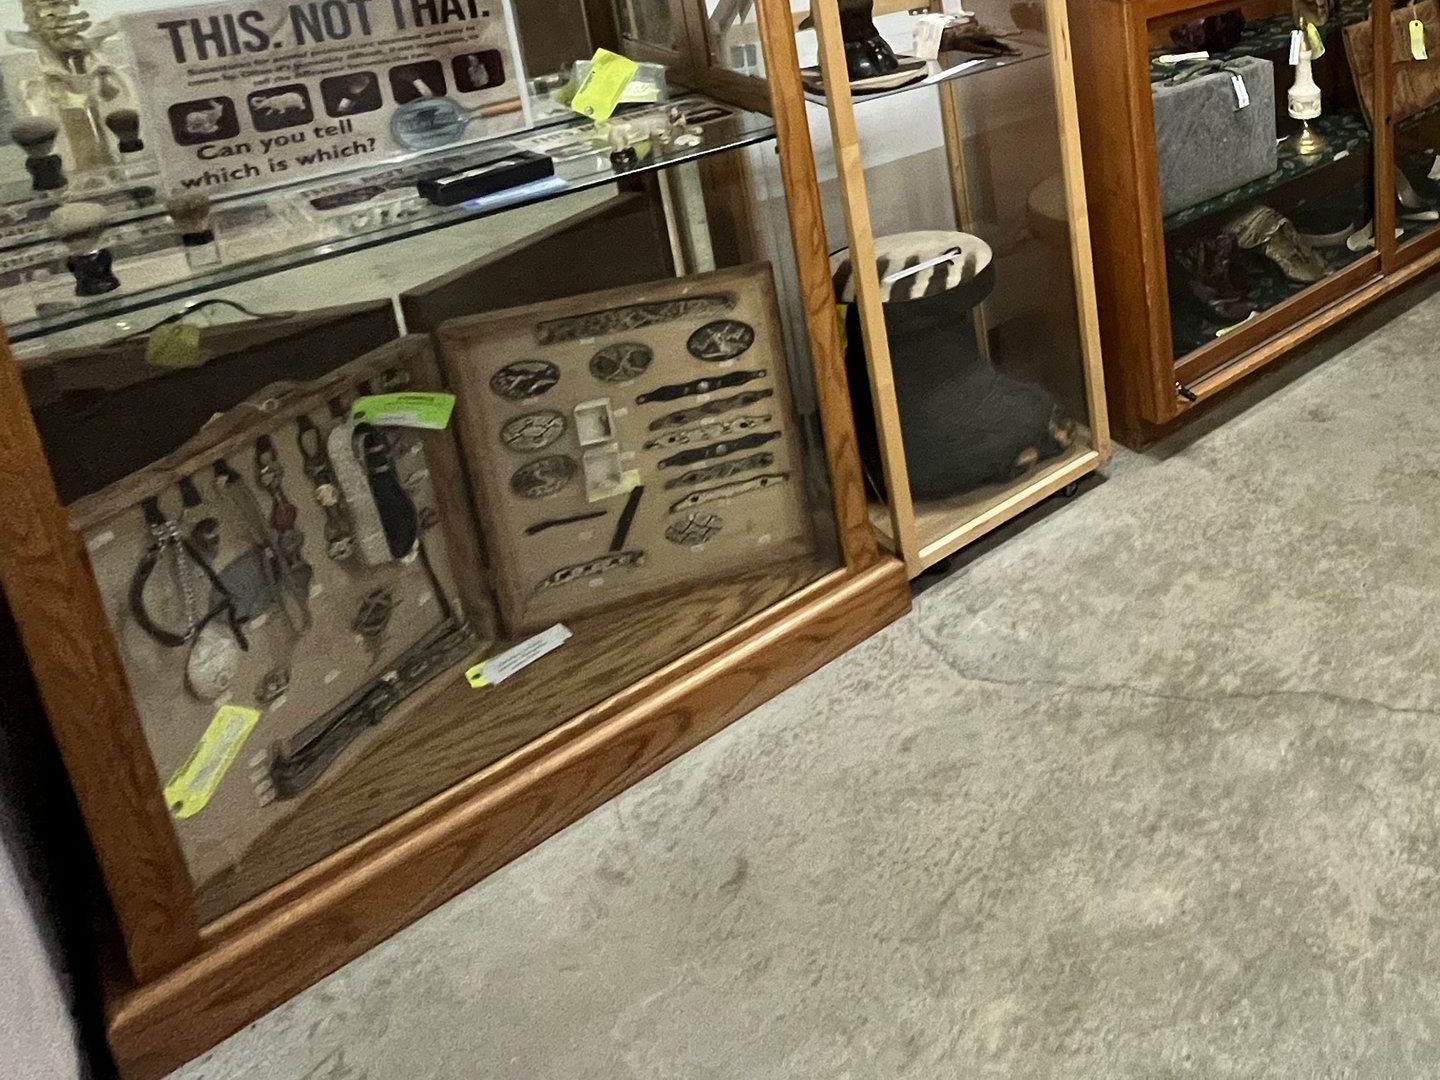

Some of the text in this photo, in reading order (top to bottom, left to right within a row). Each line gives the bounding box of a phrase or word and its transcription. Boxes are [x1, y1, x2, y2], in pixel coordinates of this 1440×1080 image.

[157, 9, 283, 64] THIS.
[181, 161, 261, 190] which
[269, 154, 289, 173] is
[295, 137, 377, 168] which?
[195, 118, 354, 162] Can you tell
